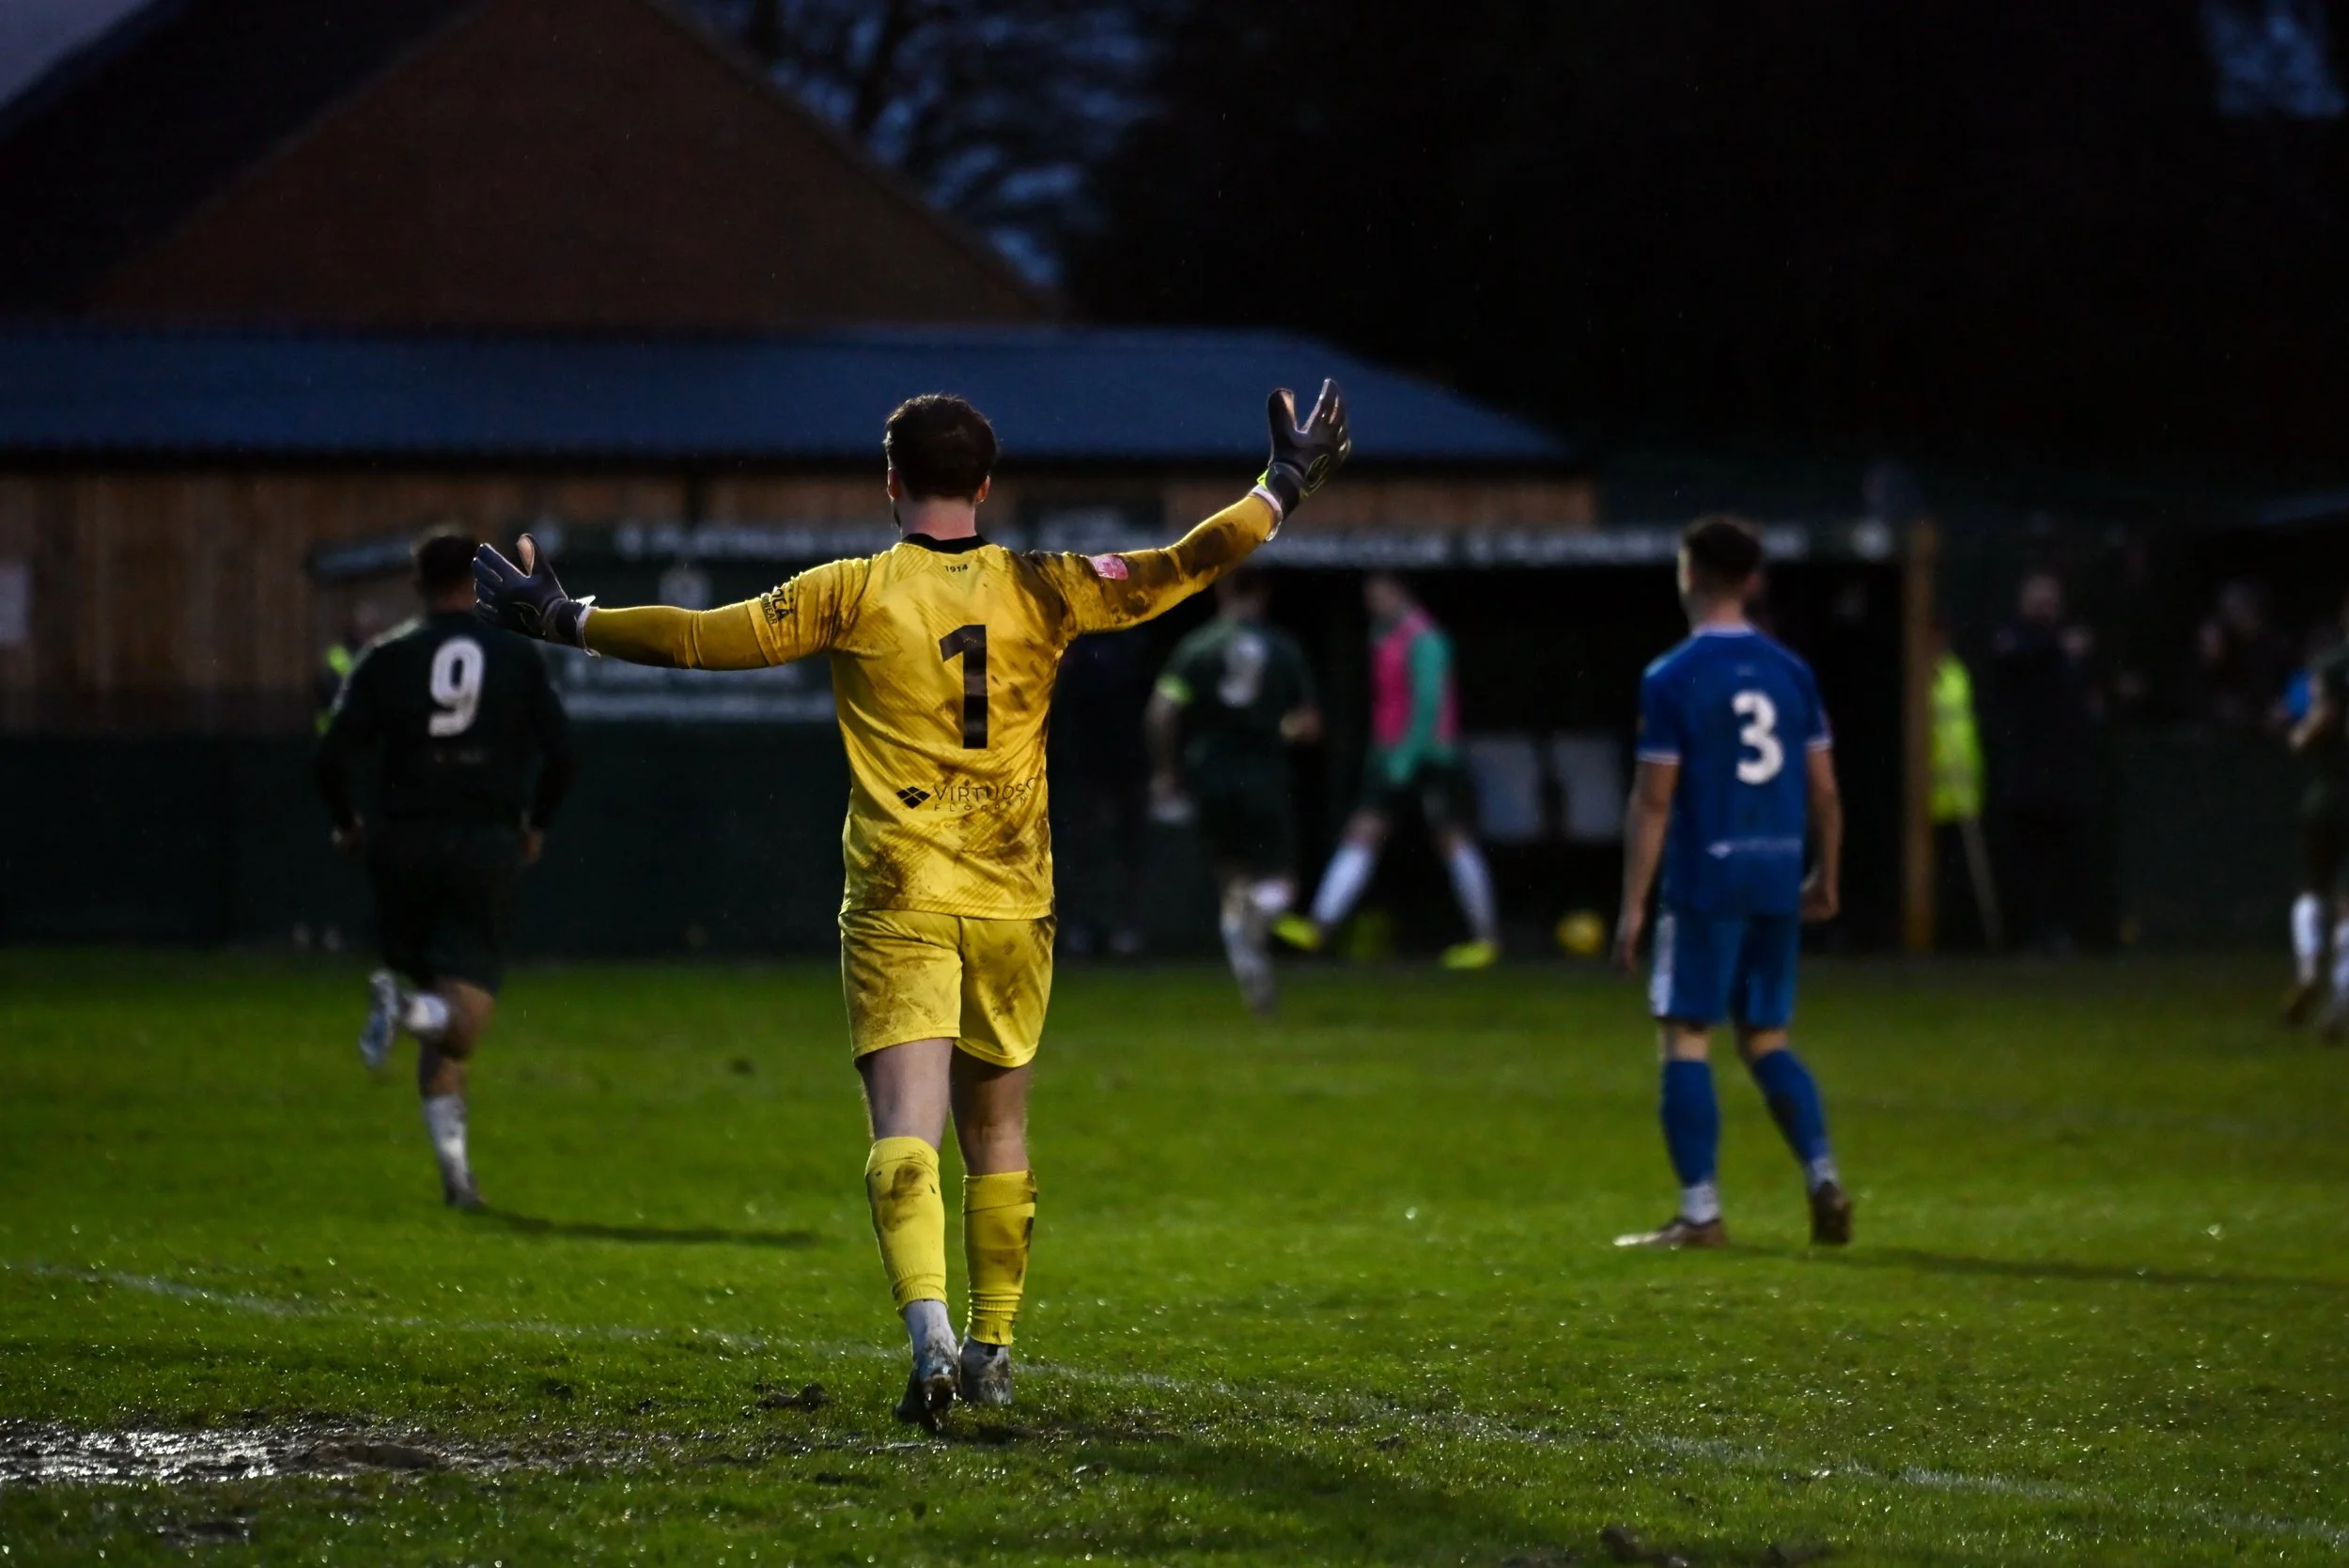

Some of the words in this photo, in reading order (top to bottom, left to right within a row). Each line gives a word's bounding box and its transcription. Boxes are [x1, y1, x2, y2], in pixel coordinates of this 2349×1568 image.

[944, 563, 969, 572] 1914
[428, 633, 487, 738] 9
[939, 625, 988, 749] 1
[1730, 688, 1786, 786] 3
